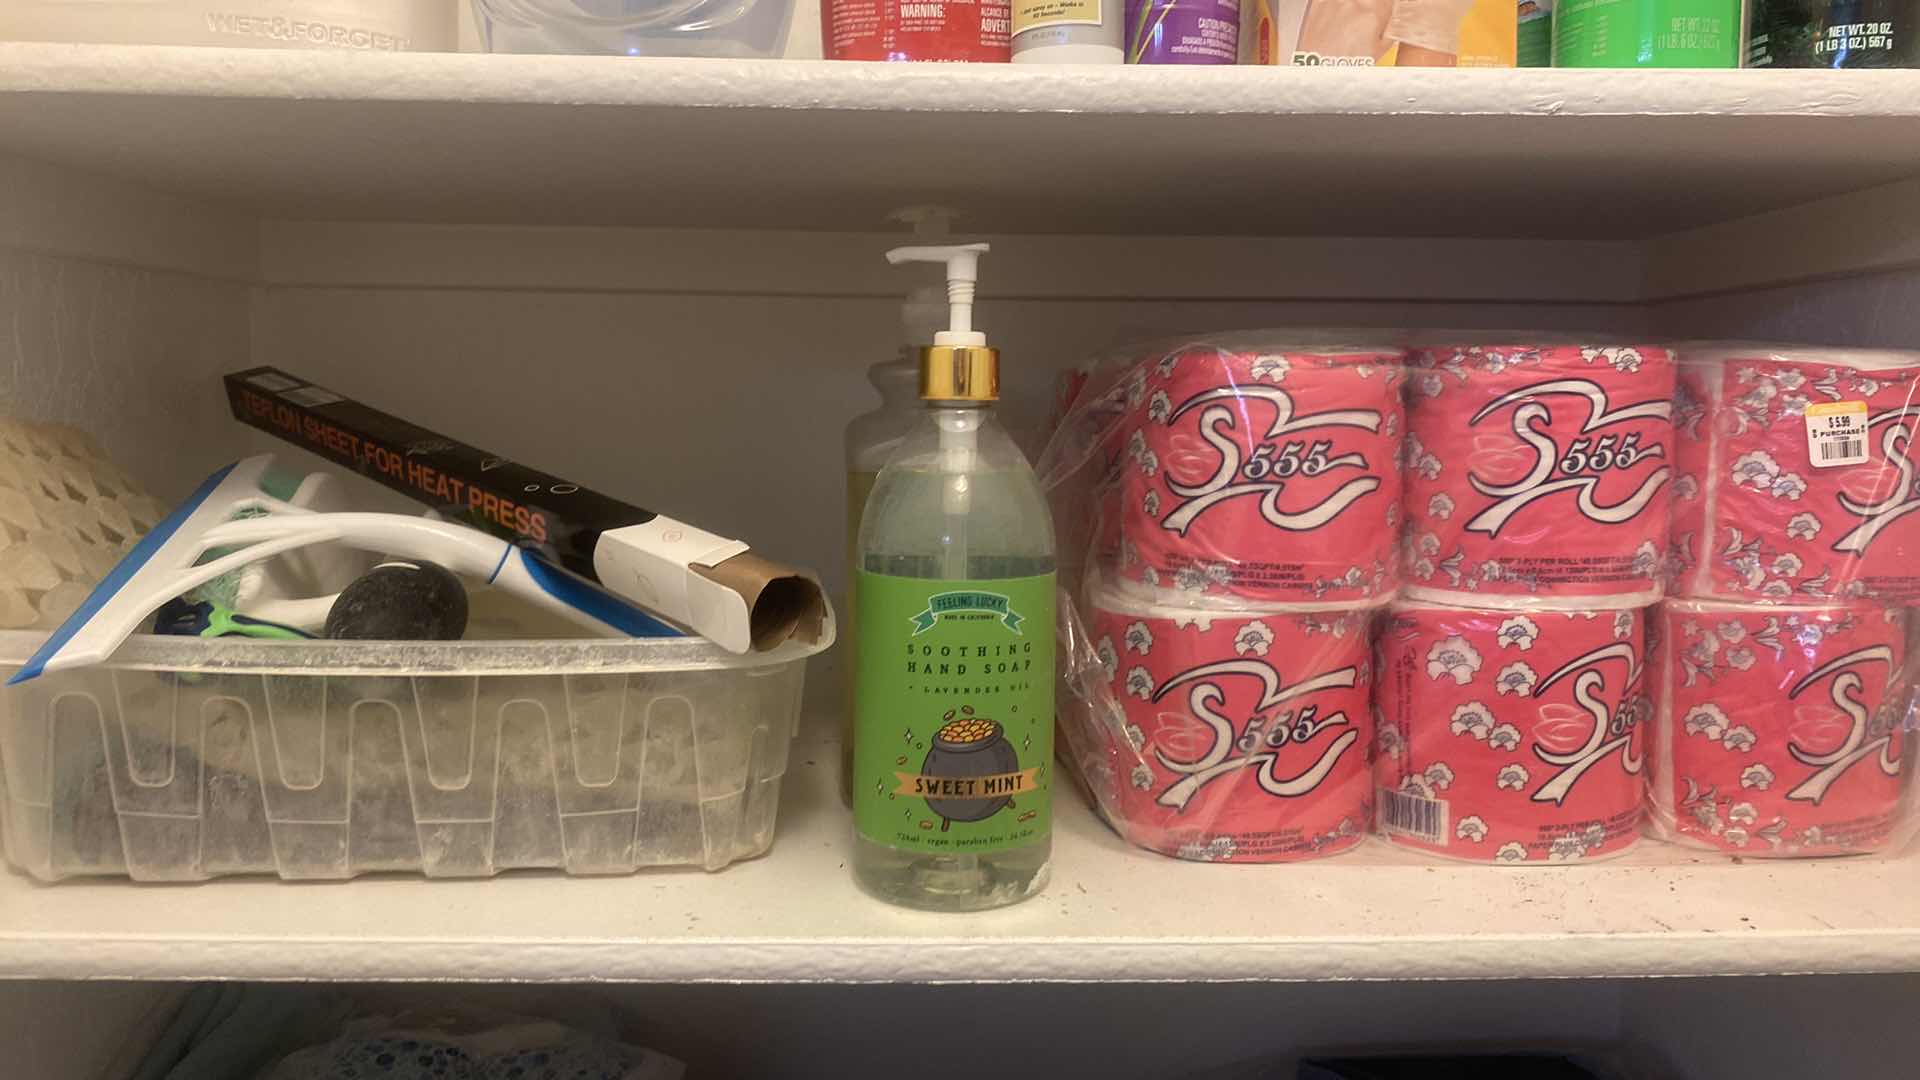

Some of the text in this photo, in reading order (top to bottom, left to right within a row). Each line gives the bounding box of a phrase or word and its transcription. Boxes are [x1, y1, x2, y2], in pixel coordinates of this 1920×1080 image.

[900, 4, 946, 18] WARNING:
[1828, 25, 1847, 38] NET
[1866, 22, 1878, 34] 20
[1826, 39, 1838, 51] LB
[1840, 38, 1847, 50] 3
[1294, 54, 1319, 66] 50
[302, 415, 359, 458] SHEET
[362, 441, 404, 480] FOR
[408, 460, 464, 505] HEAT
[467, 484, 548, 544] PRESS
[937, 595, 973, 609] FEELING
[907, 642, 1031, 657] SOOTHING
[907, 660, 1031, 676] HAND SOAP
[924, 685, 1000, 695] LAVENDER
[915, 774, 1024, 795] SWEET MINT
[956, 838, 988, 847] paraben
